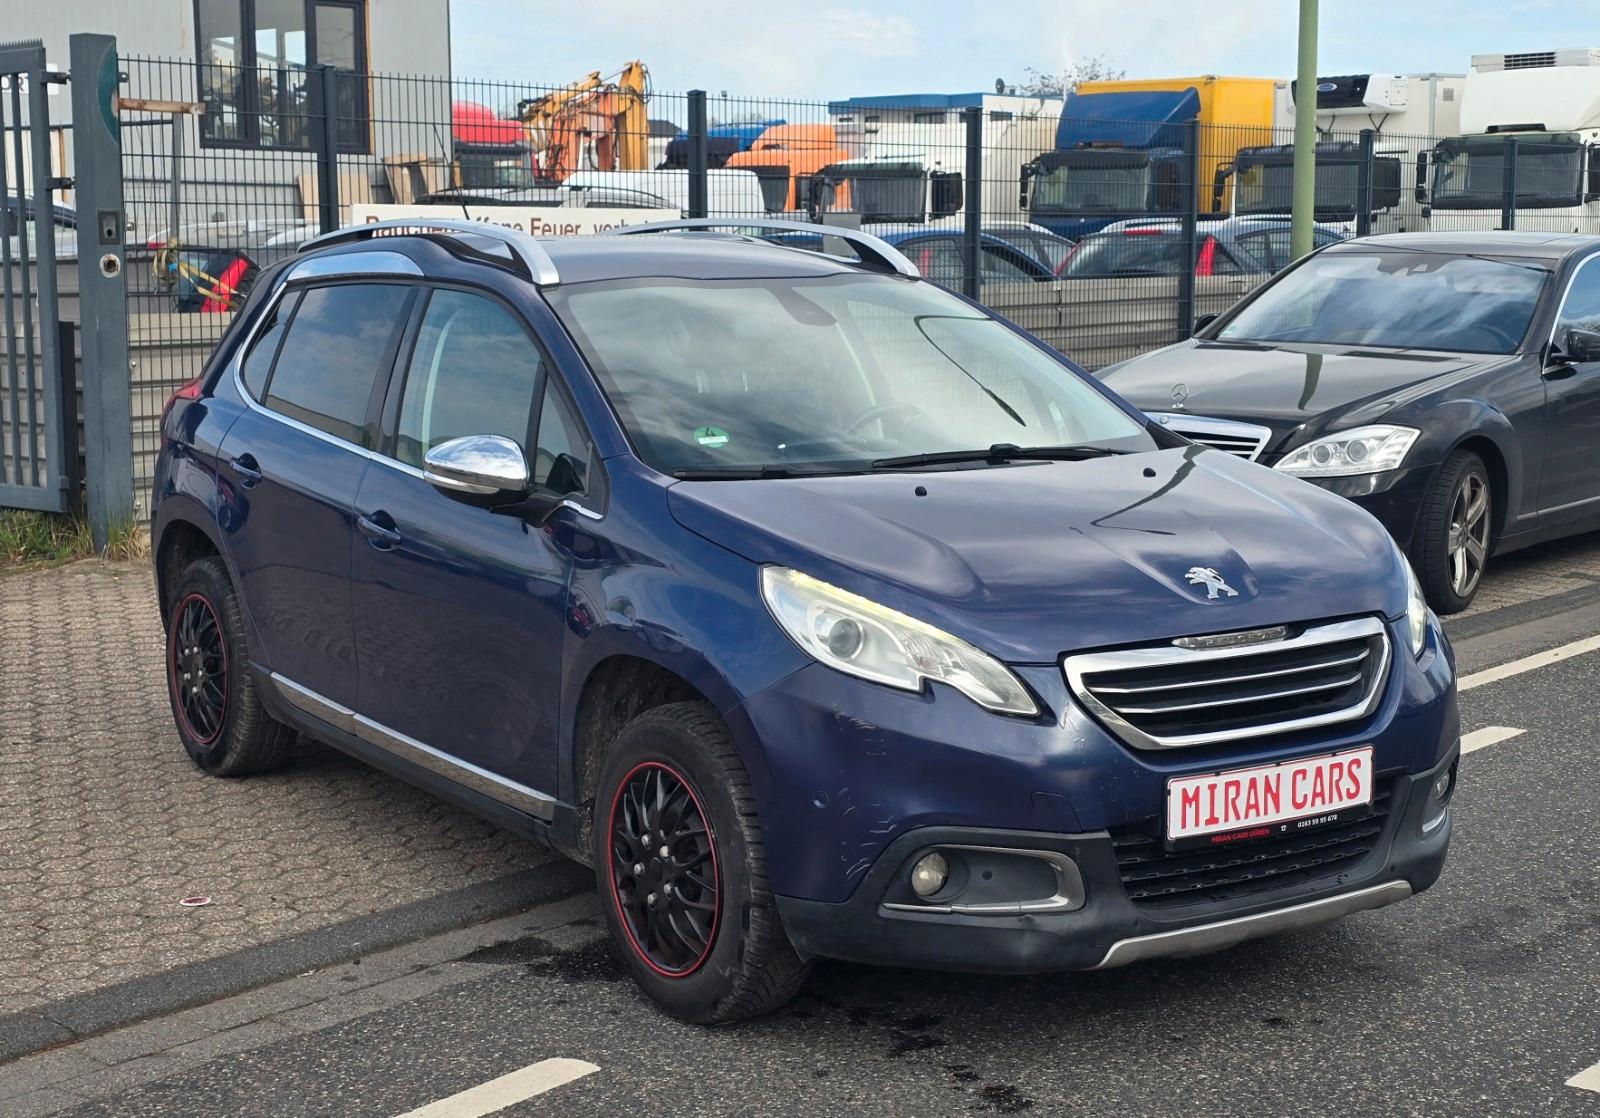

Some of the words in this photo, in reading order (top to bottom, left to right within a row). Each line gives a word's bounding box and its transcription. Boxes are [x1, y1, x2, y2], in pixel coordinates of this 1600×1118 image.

[530, 217, 581, 236] Feuer
[1181, 773, 1280, 829] MIRAN
[1291, 758, 1362, 810] CARS
